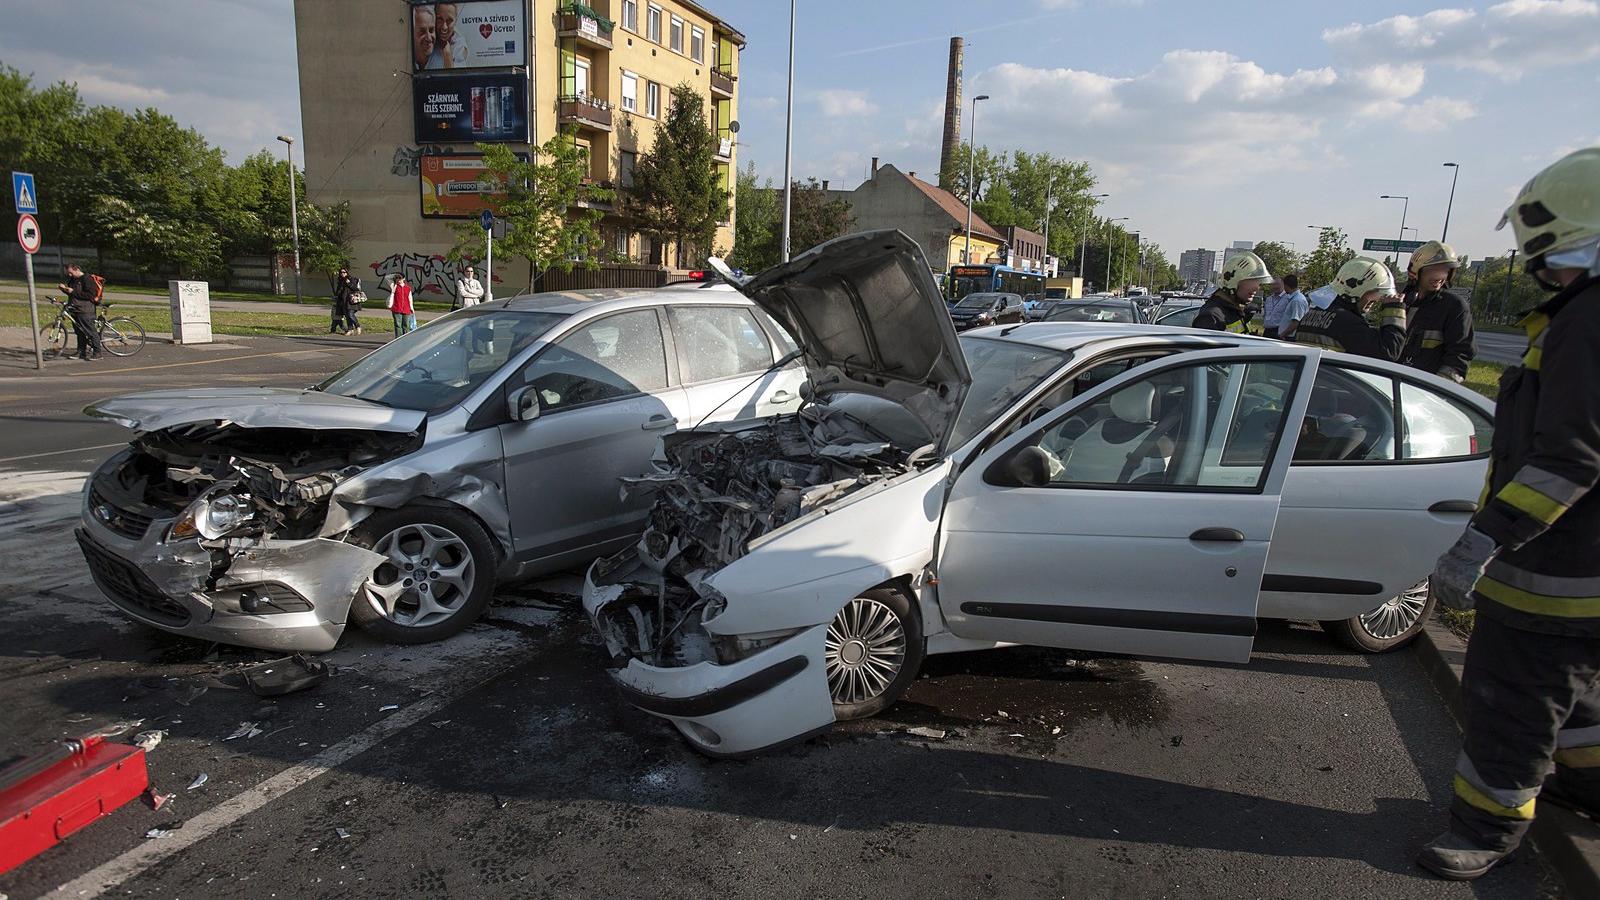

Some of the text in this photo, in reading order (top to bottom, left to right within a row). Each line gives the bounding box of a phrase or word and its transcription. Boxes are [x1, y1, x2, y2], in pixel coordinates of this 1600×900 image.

[461, 16, 483, 24] LEGYEN
[489, 13, 509, 22] SZÍVED
[493, 25, 516, 33] ÜGYED!
[427, 92, 459, 103] SZÁRNYAK
[423, 102, 464, 113] ÍZLÉS SZERINT.
